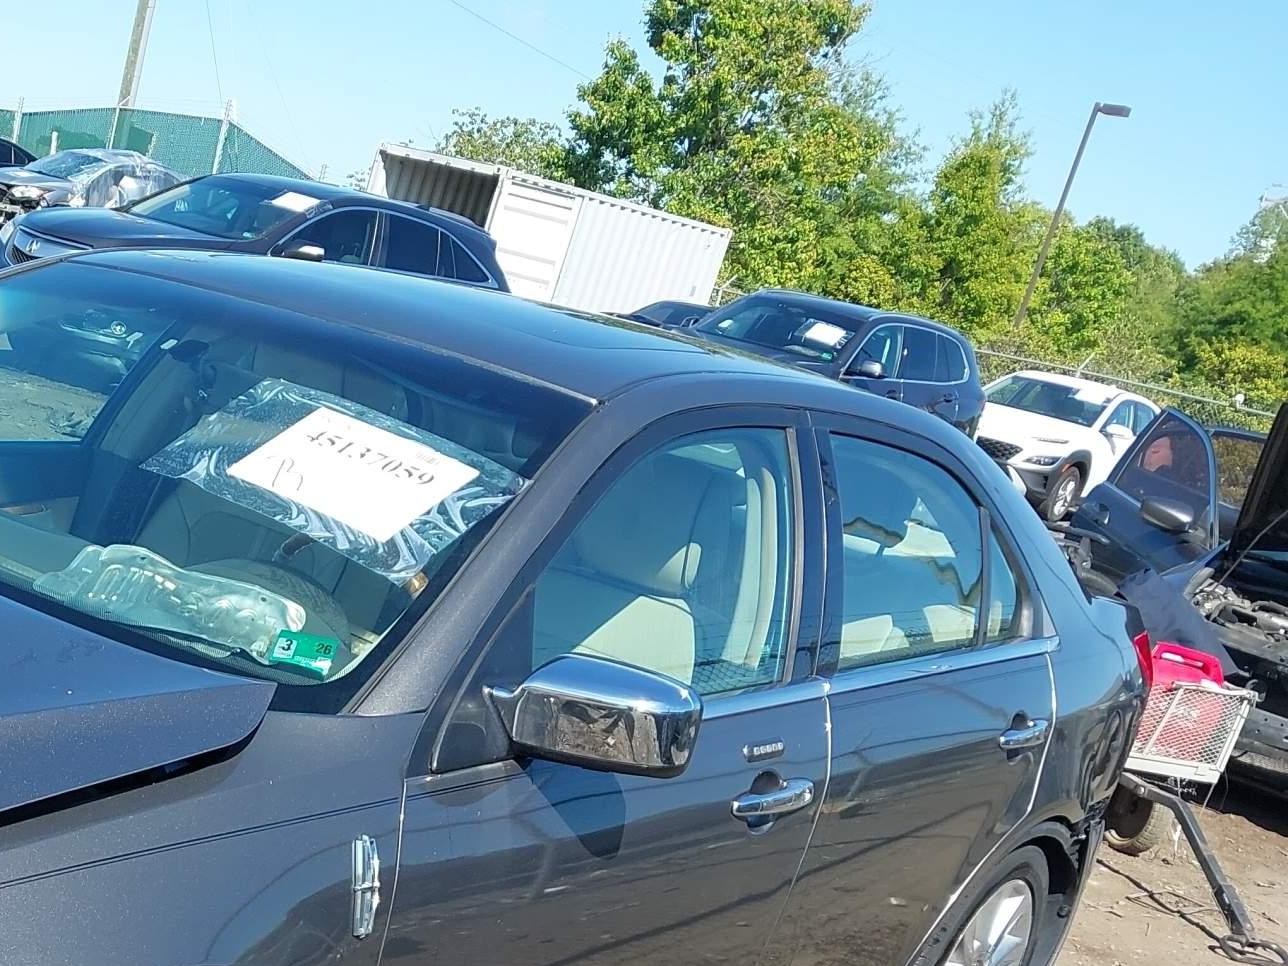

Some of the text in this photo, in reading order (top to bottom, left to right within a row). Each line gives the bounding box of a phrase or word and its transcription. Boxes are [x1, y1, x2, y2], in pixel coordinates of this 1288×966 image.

[306, 431, 435, 485] 45137059
[281, 639, 293, 651] 3
[315, 642, 333, 656] 26
